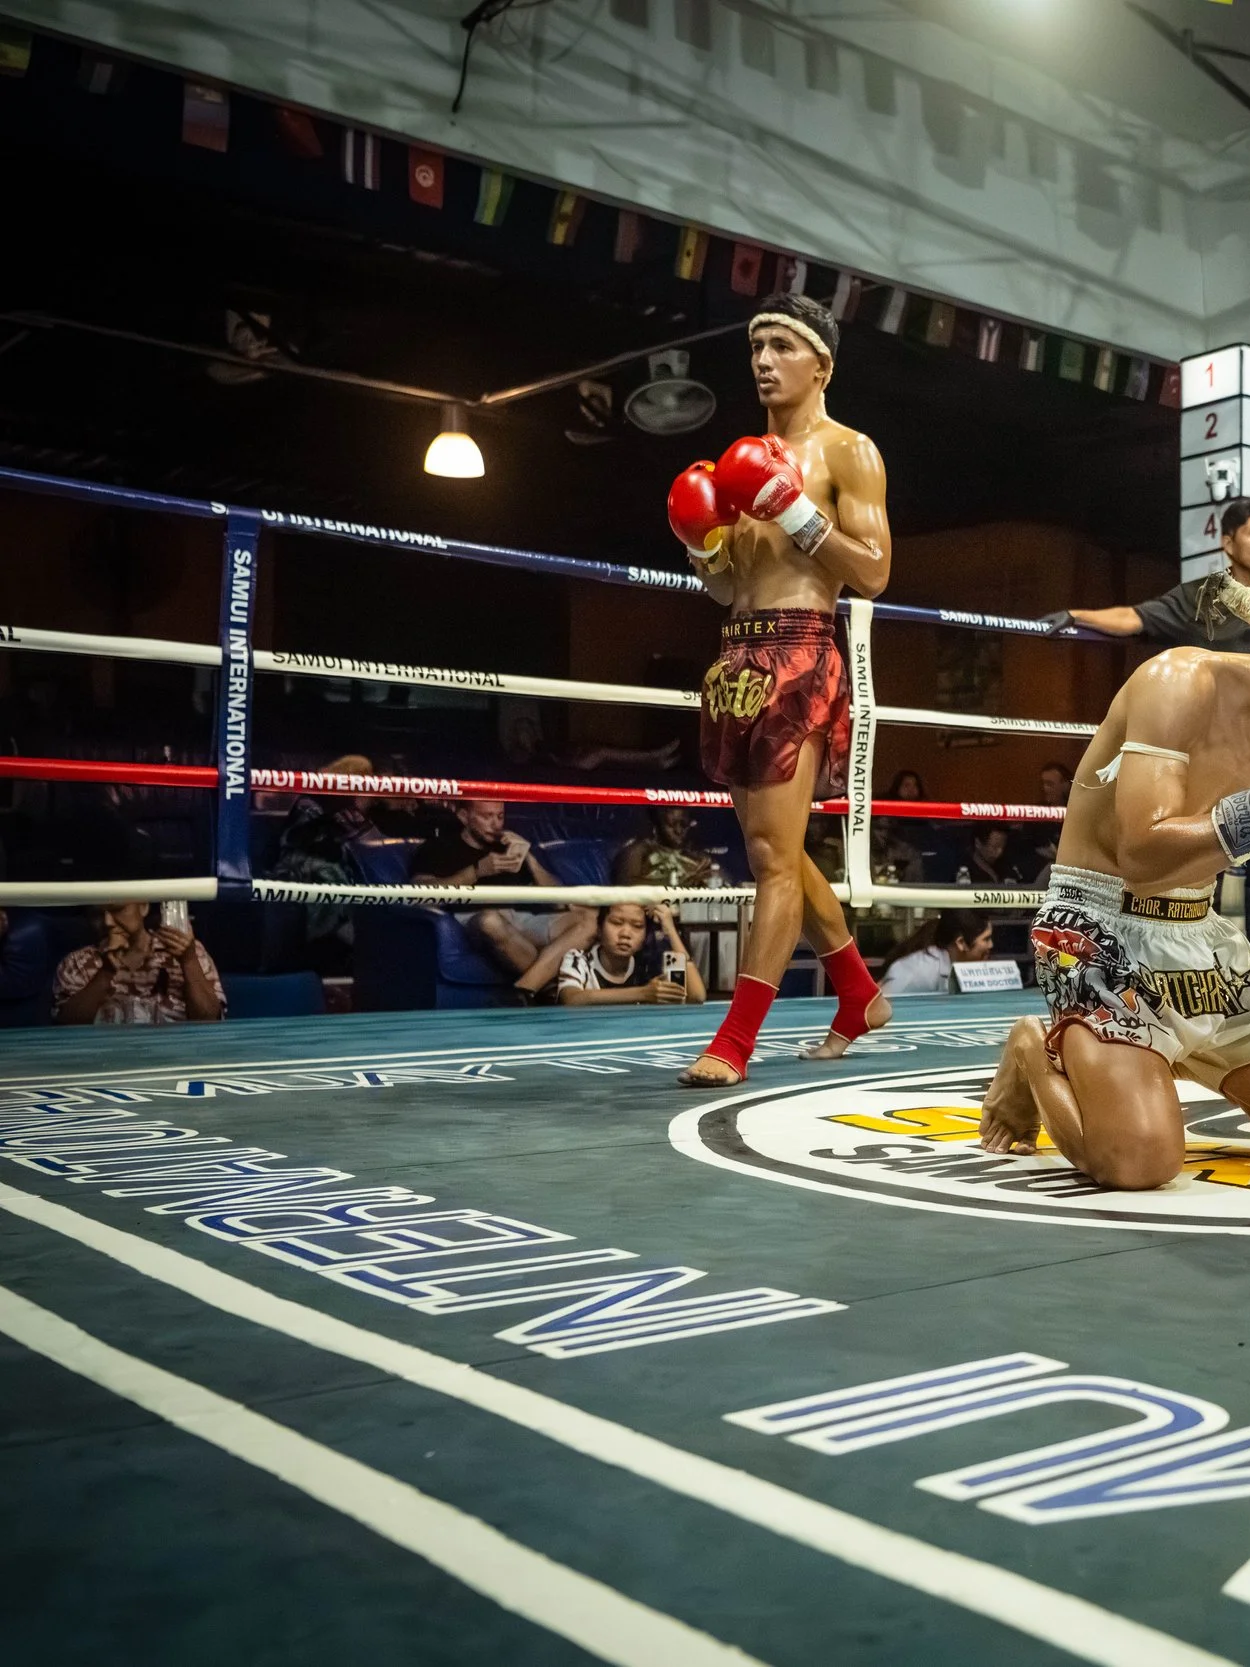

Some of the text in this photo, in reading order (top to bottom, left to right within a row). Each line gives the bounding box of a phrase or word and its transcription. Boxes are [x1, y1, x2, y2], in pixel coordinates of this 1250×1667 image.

[1205, 362, 1214, 388] 1
[1204, 412, 1218, 440] 2
[1203, 513, 1217, 539] 4
[627, 565, 681, 589] SAMUI
[939, 609, 983, 625] SAMUI
[225, 549, 252, 801] SAMUI INTERNATIONAL
[272, 651, 506, 688] SAMUI INTERNATIONAL
[851, 643, 871, 837] SAMUI INTERNATIONAL
[250, 768, 463, 796] MUI INTERNATIONAL
[645, 788, 702, 804] SAMUI
[960, 802, 1004, 817] SAMUI
[973, 891, 1015, 904] SAMUI
[963, 977, 1020, 989] TEAM DOCTOR
